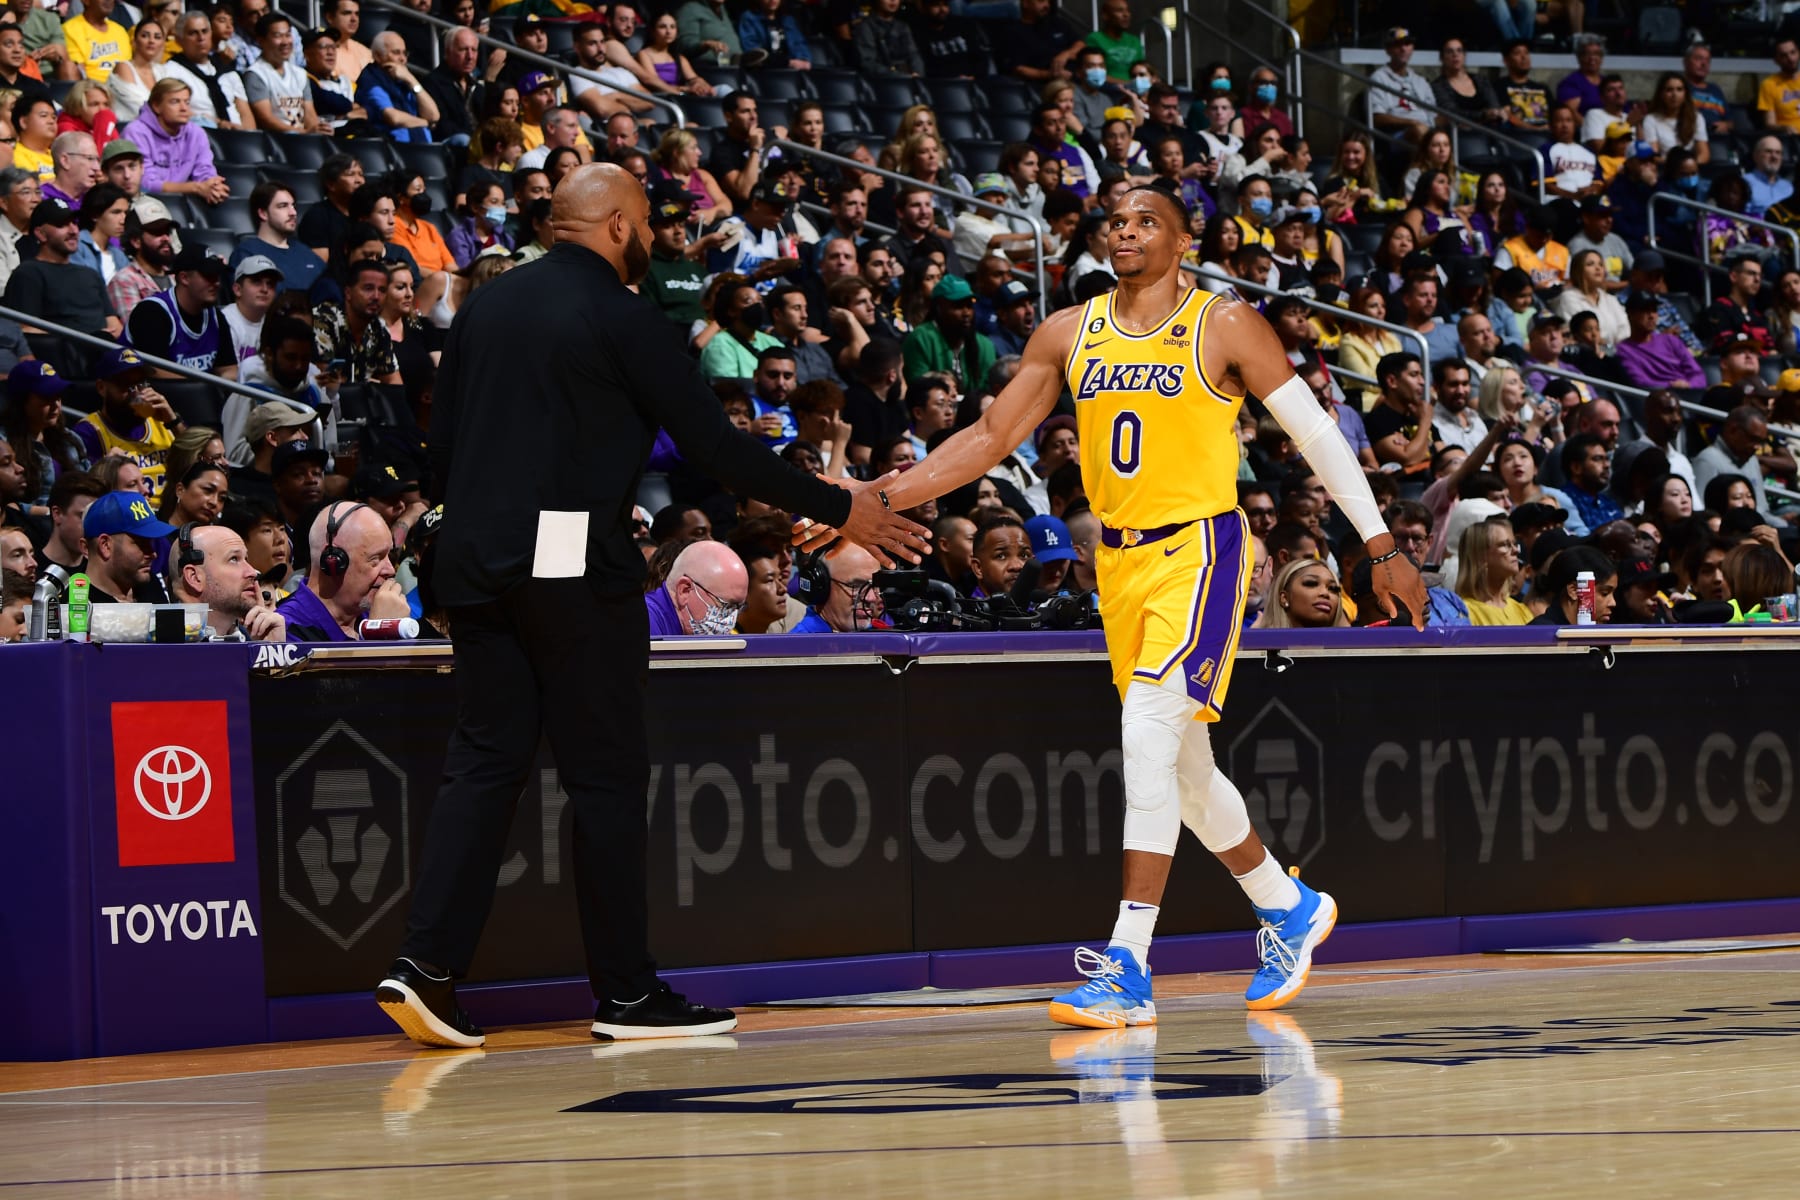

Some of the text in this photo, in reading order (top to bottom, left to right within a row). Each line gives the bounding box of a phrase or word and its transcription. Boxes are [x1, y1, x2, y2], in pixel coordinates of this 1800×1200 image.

[1091, 318, 1103, 333] 6
[1163, 338, 1190, 349] bibigo
[1077, 362, 1185, 403] LAKERS
[1111, 410, 1144, 479] 0
[130, 500, 150, 520] NY
[1044, 528, 1059, 546] LA
[253, 644, 301, 669] ANC
[101, 899, 258, 944] TOYOTA
